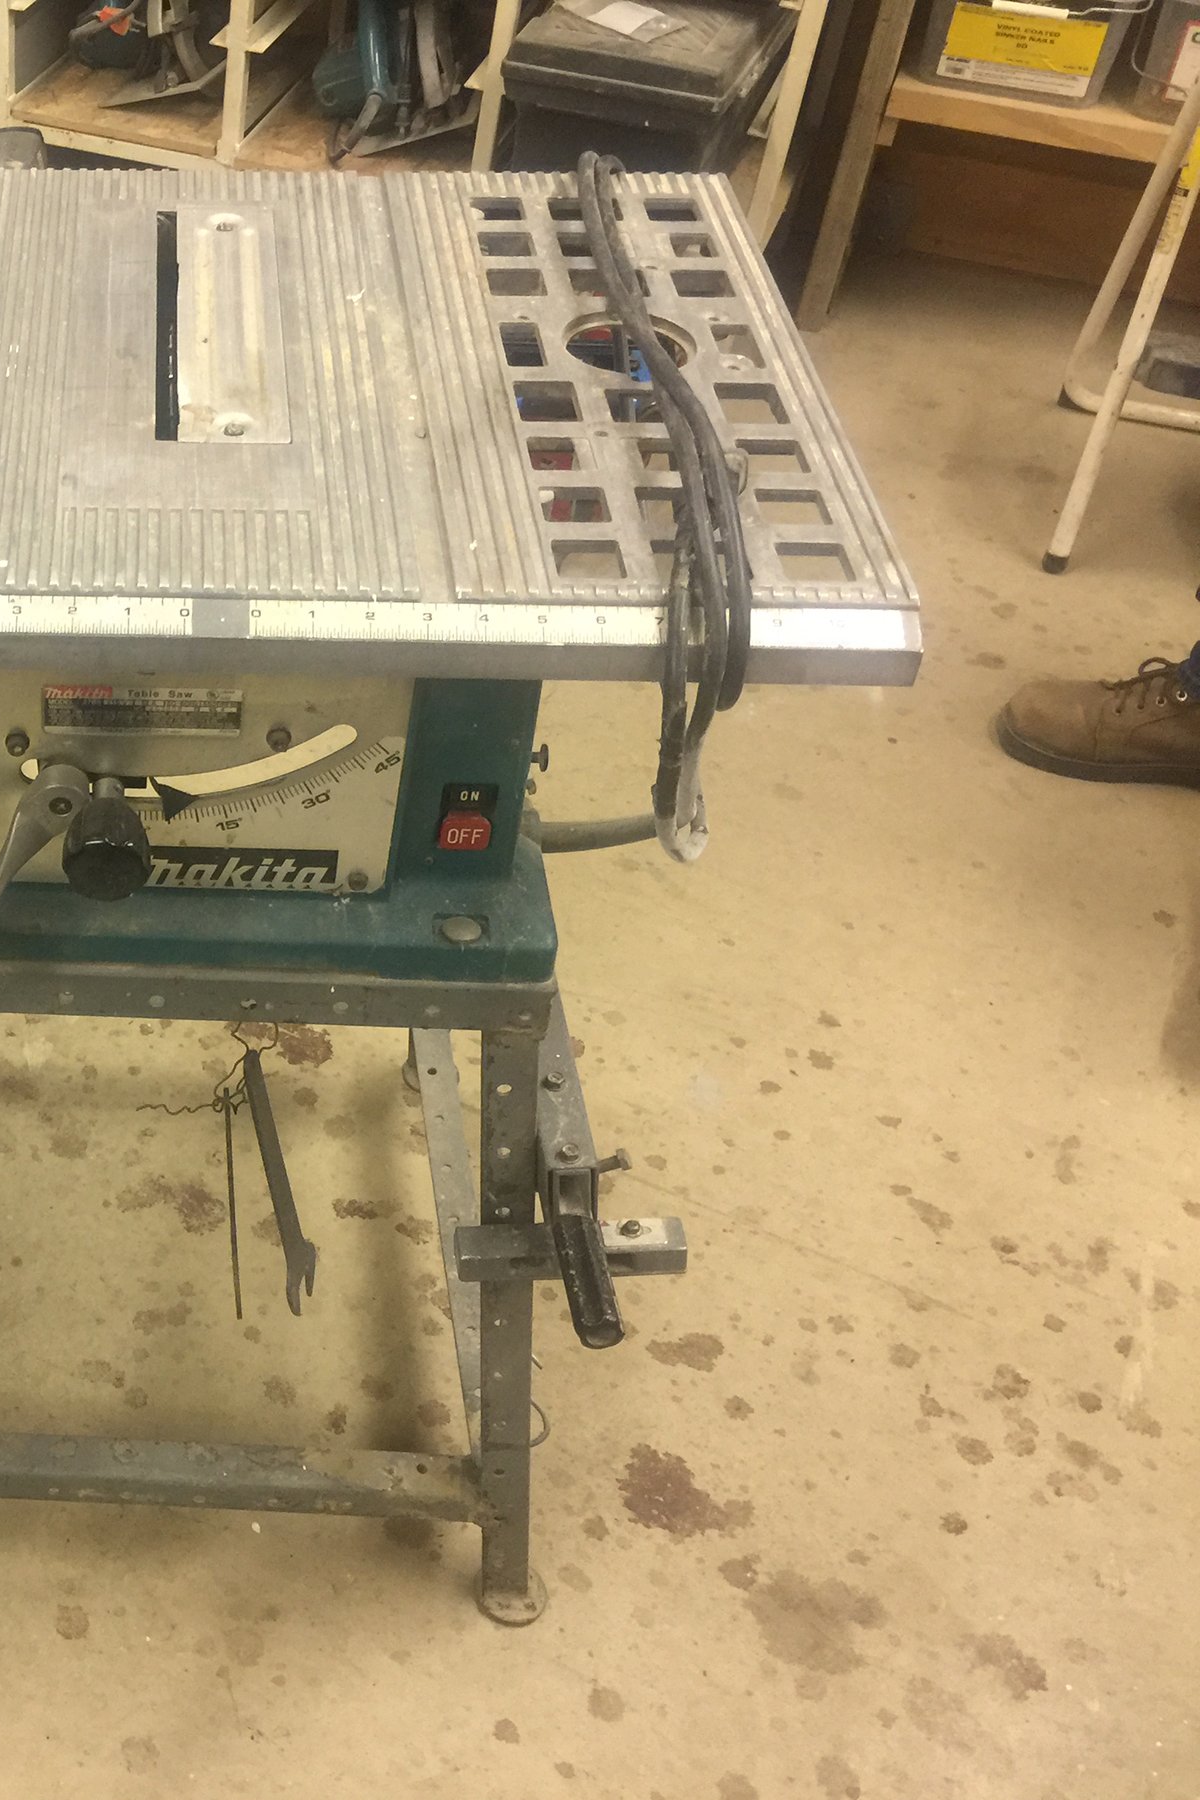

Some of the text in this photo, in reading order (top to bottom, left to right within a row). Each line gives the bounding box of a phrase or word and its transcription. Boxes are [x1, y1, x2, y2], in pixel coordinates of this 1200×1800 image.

[12, 605, 22, 615] 3
[67, 606, 78, 615] 2
[124, 607, 131, 616] 1
[179, 608, 190, 617] 0
[251, 609, 262, 618] 0
[308, 610, 316, 619] 1
[365, 611, 376, 620] 2
[422, 612, 433, 622] 3
[478, 614, 489, 623] 4
[537, 615, 548, 624] 5
[596, 615, 607, 625] 6
[654, 616, 665, 626] 7
[772, 618, 783, 627] 9
[127, 689, 160, 698] Table
[168, 690, 193, 699] Saw
[460, 790, 480, 801] ON
[447, 828, 484, 844] OFF
